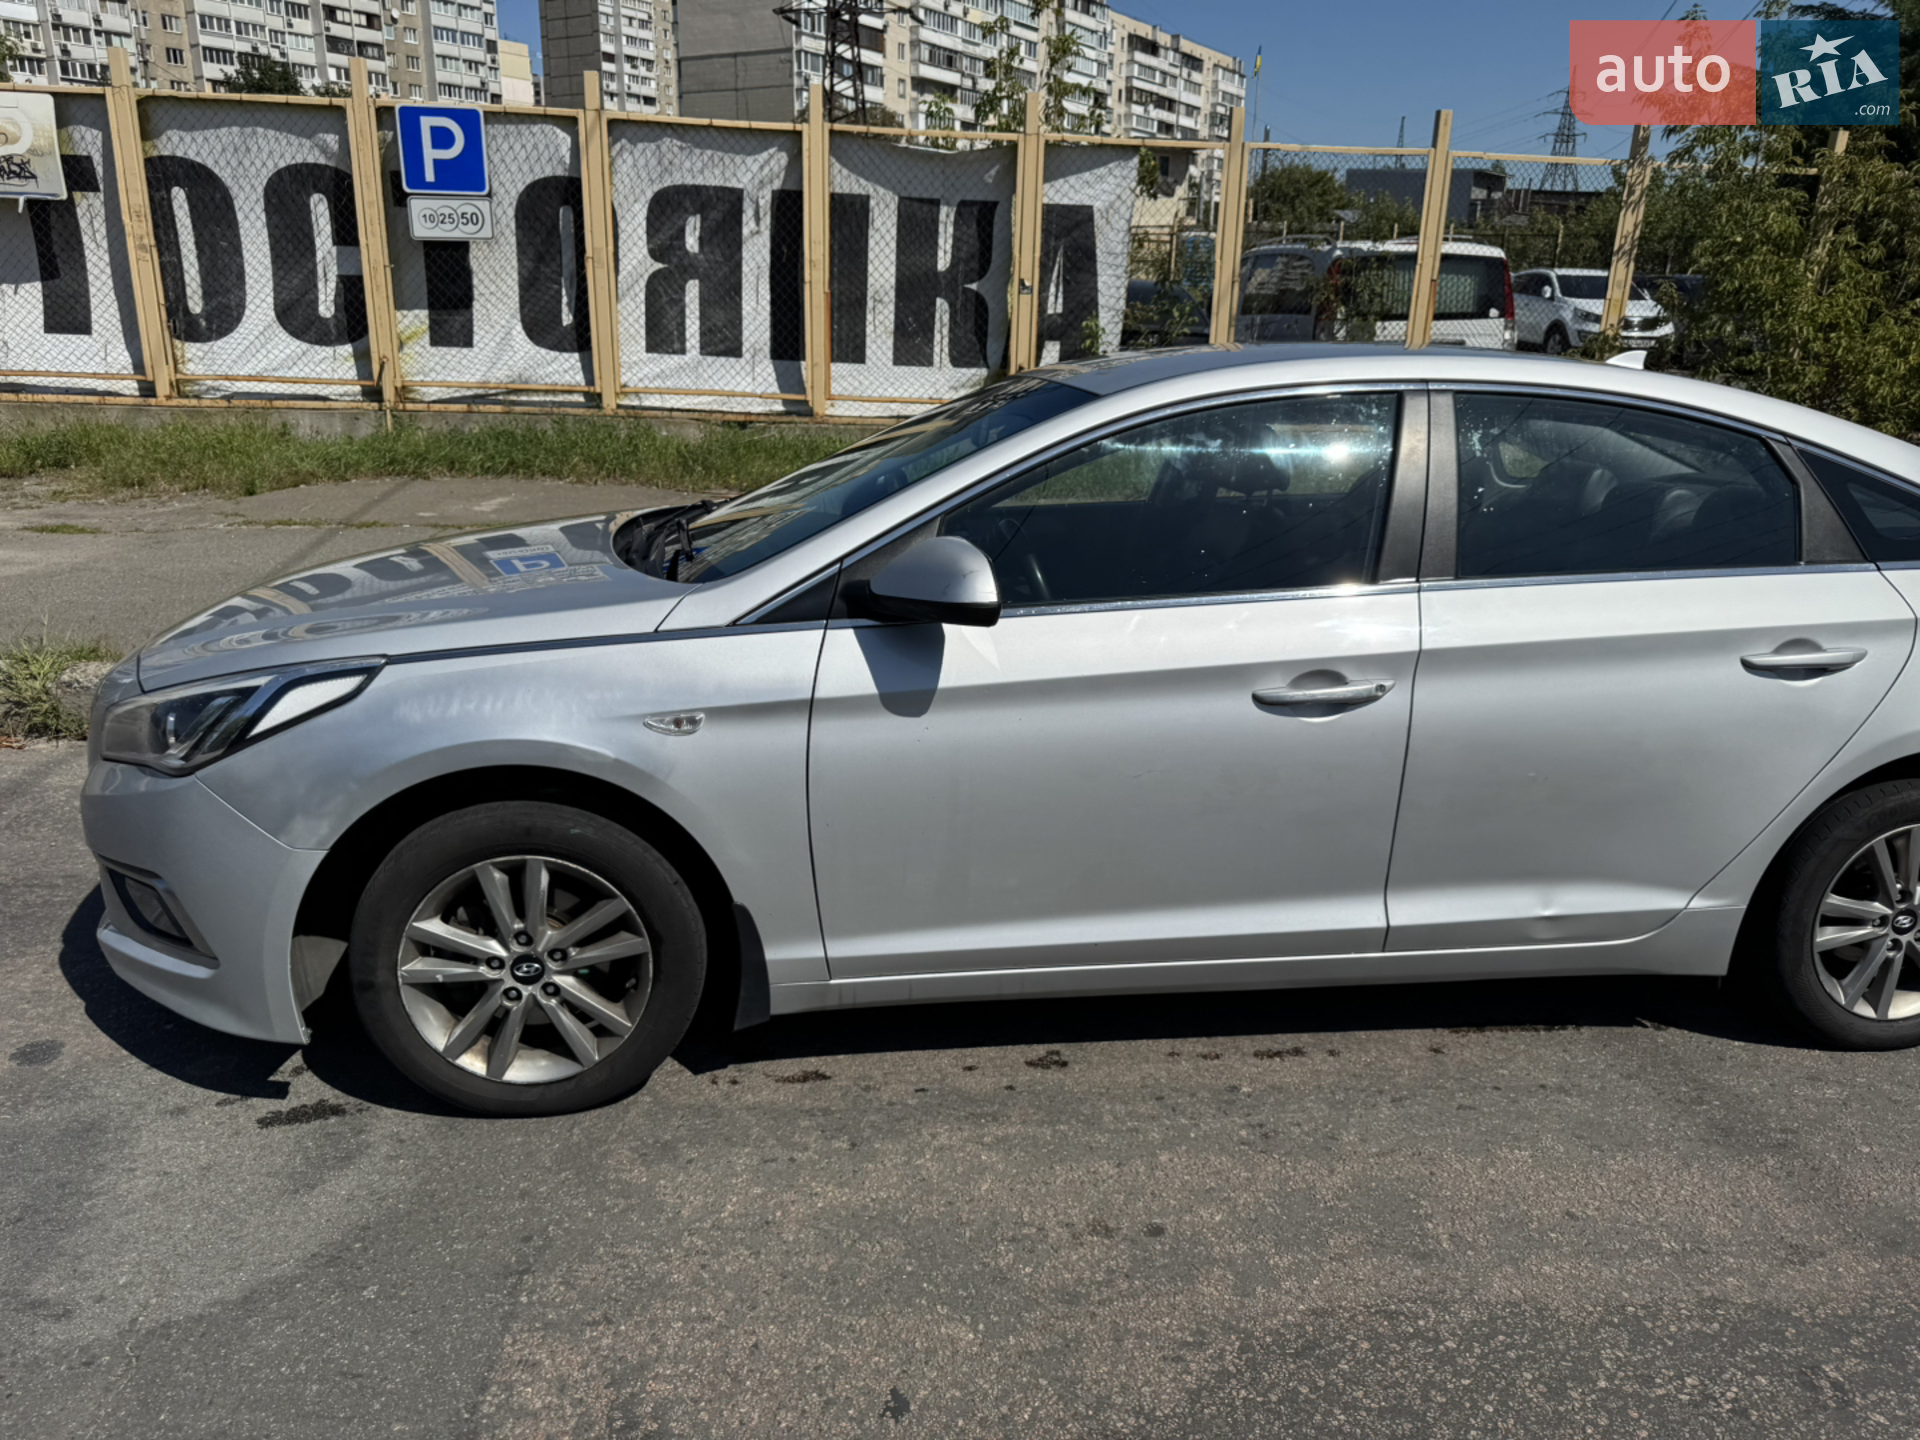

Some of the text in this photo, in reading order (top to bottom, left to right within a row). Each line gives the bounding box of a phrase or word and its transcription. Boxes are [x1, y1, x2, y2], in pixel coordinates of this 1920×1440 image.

[420, 115, 465, 182] P
[421, 212, 480, 226] 10 25 50
